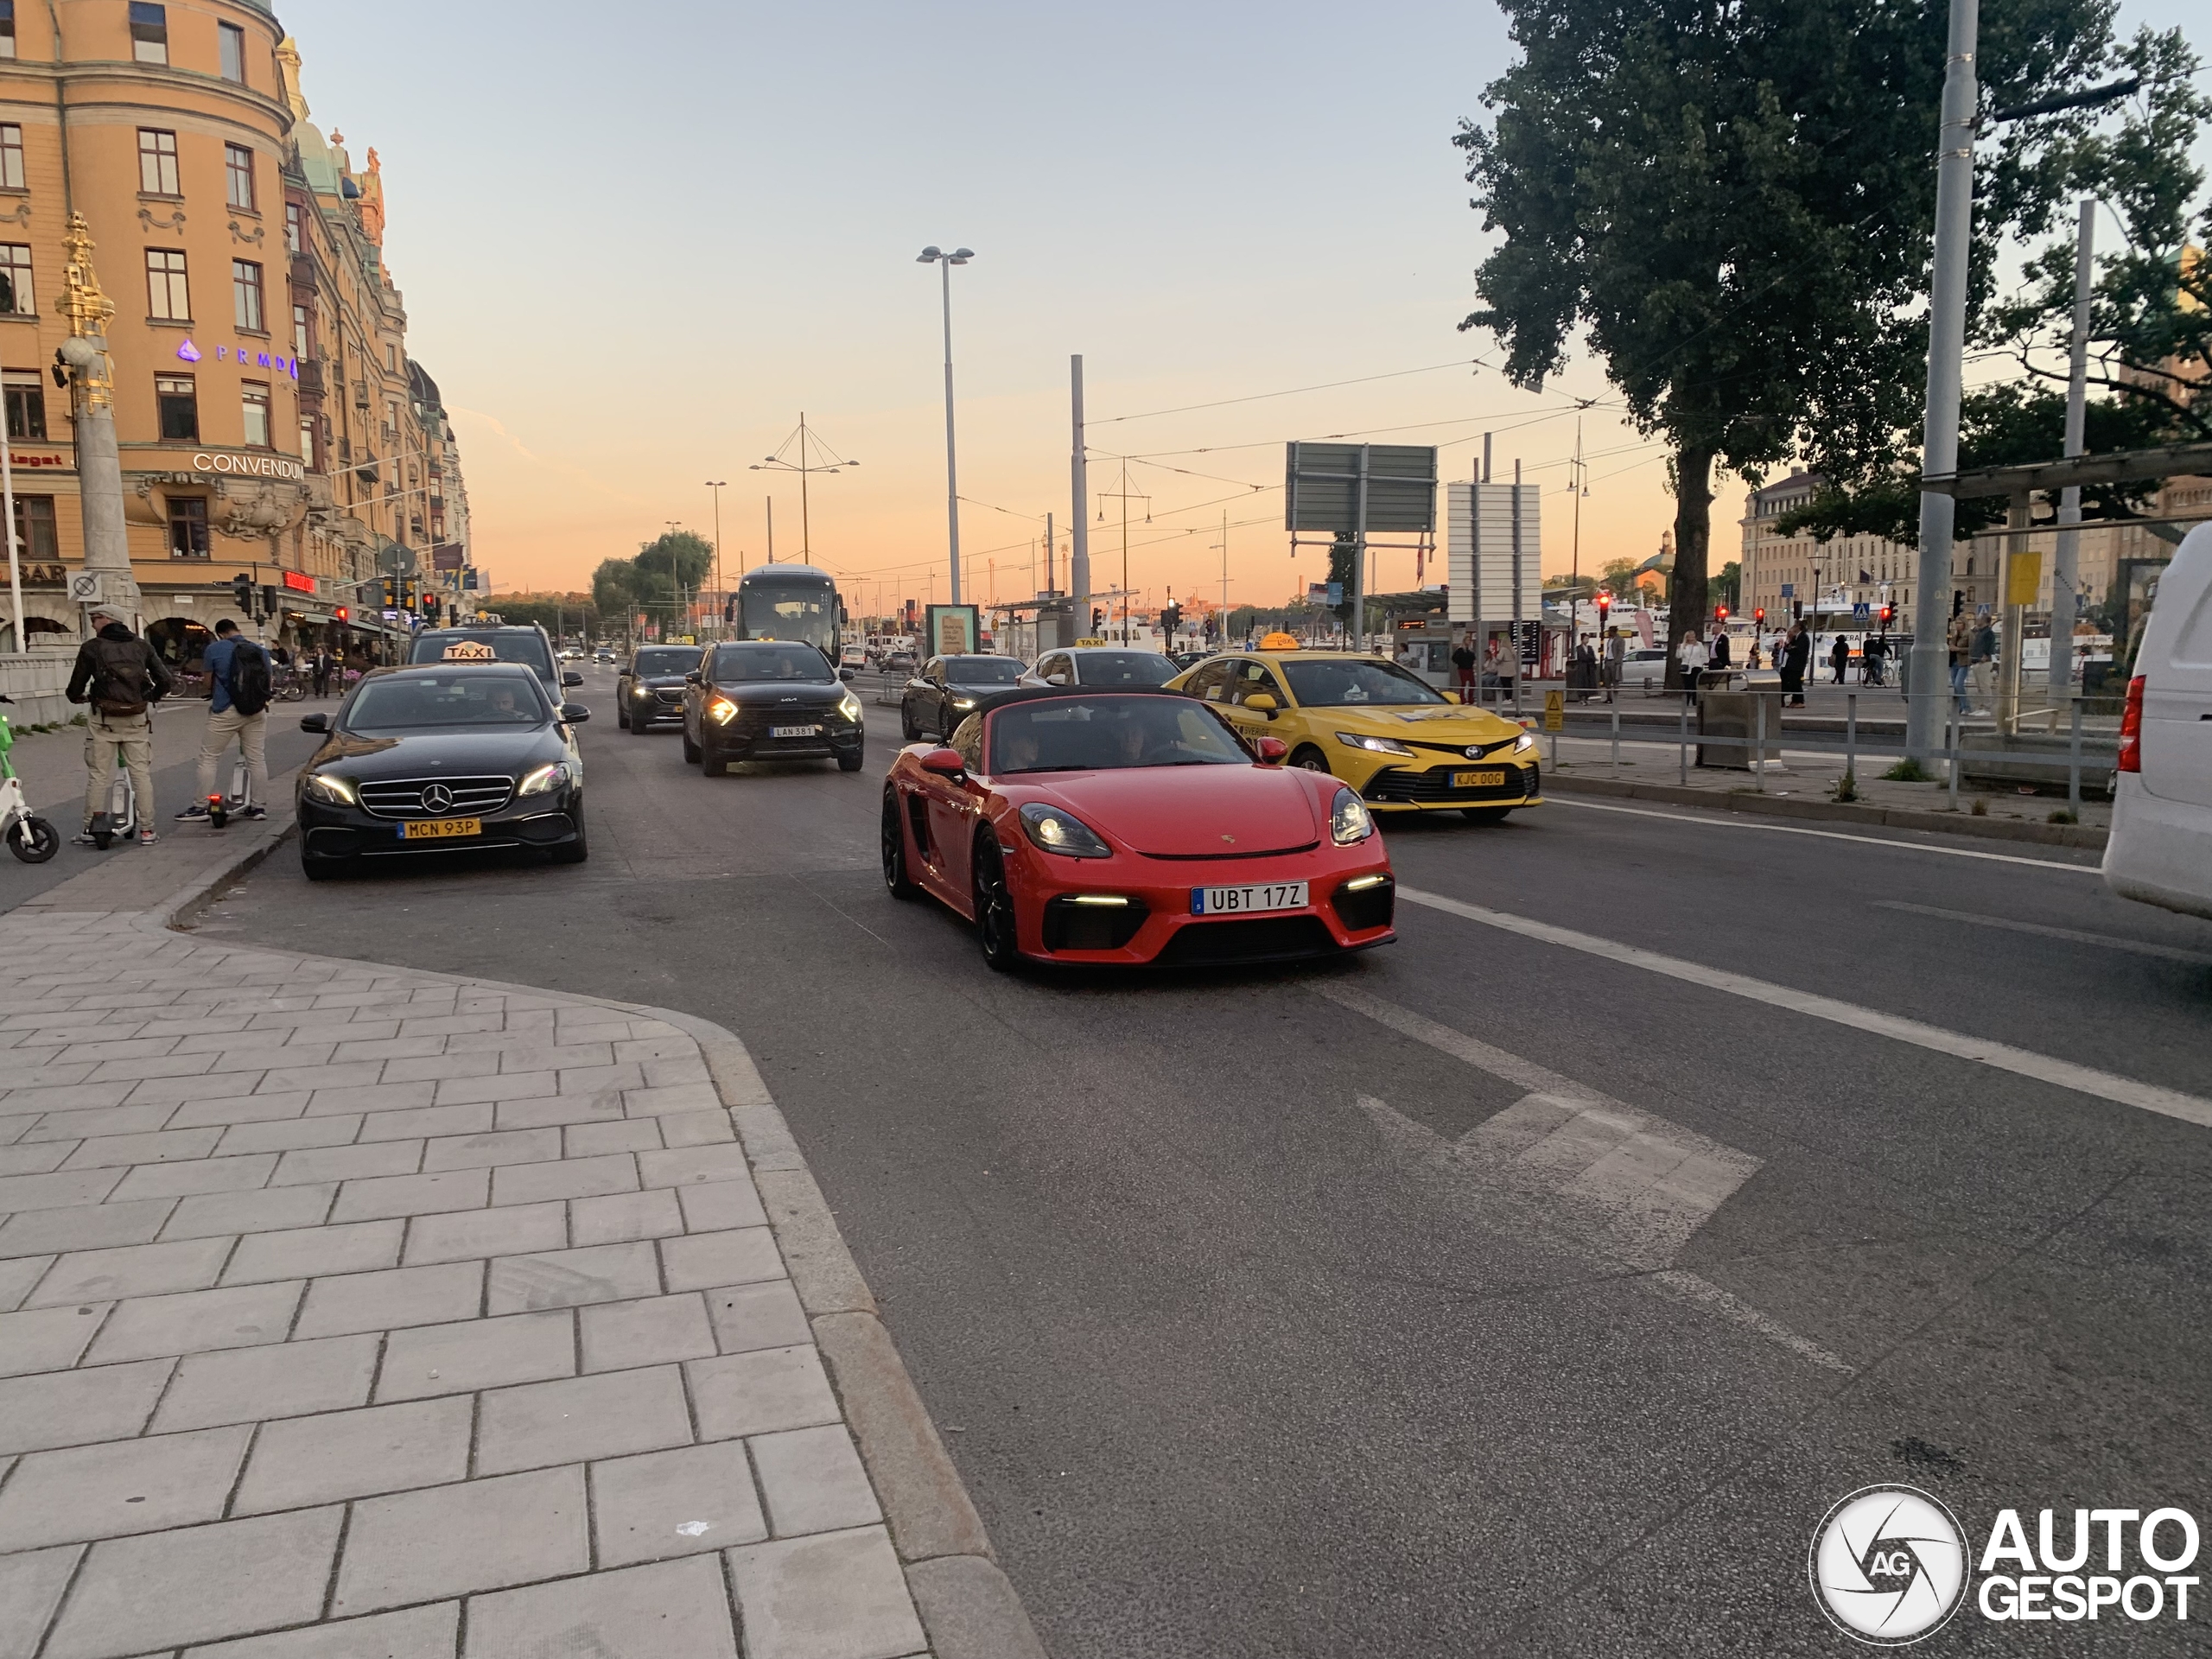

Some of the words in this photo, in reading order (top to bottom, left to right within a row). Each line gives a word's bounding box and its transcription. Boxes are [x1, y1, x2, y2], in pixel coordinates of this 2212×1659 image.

[193, 453, 305, 480] CONVENDUM
[447, 647, 493, 658] TAXI
[777, 728, 793, 736] LAN
[1244, 726, 1270, 737] SVERIGE
[1457, 773, 1477, 785] KJC
[409, 823, 439, 837] MCN
[444, 821, 474, 835] 93P
[1212, 888, 1254, 910] UBT
[1263, 885, 1300, 907] 17Z
